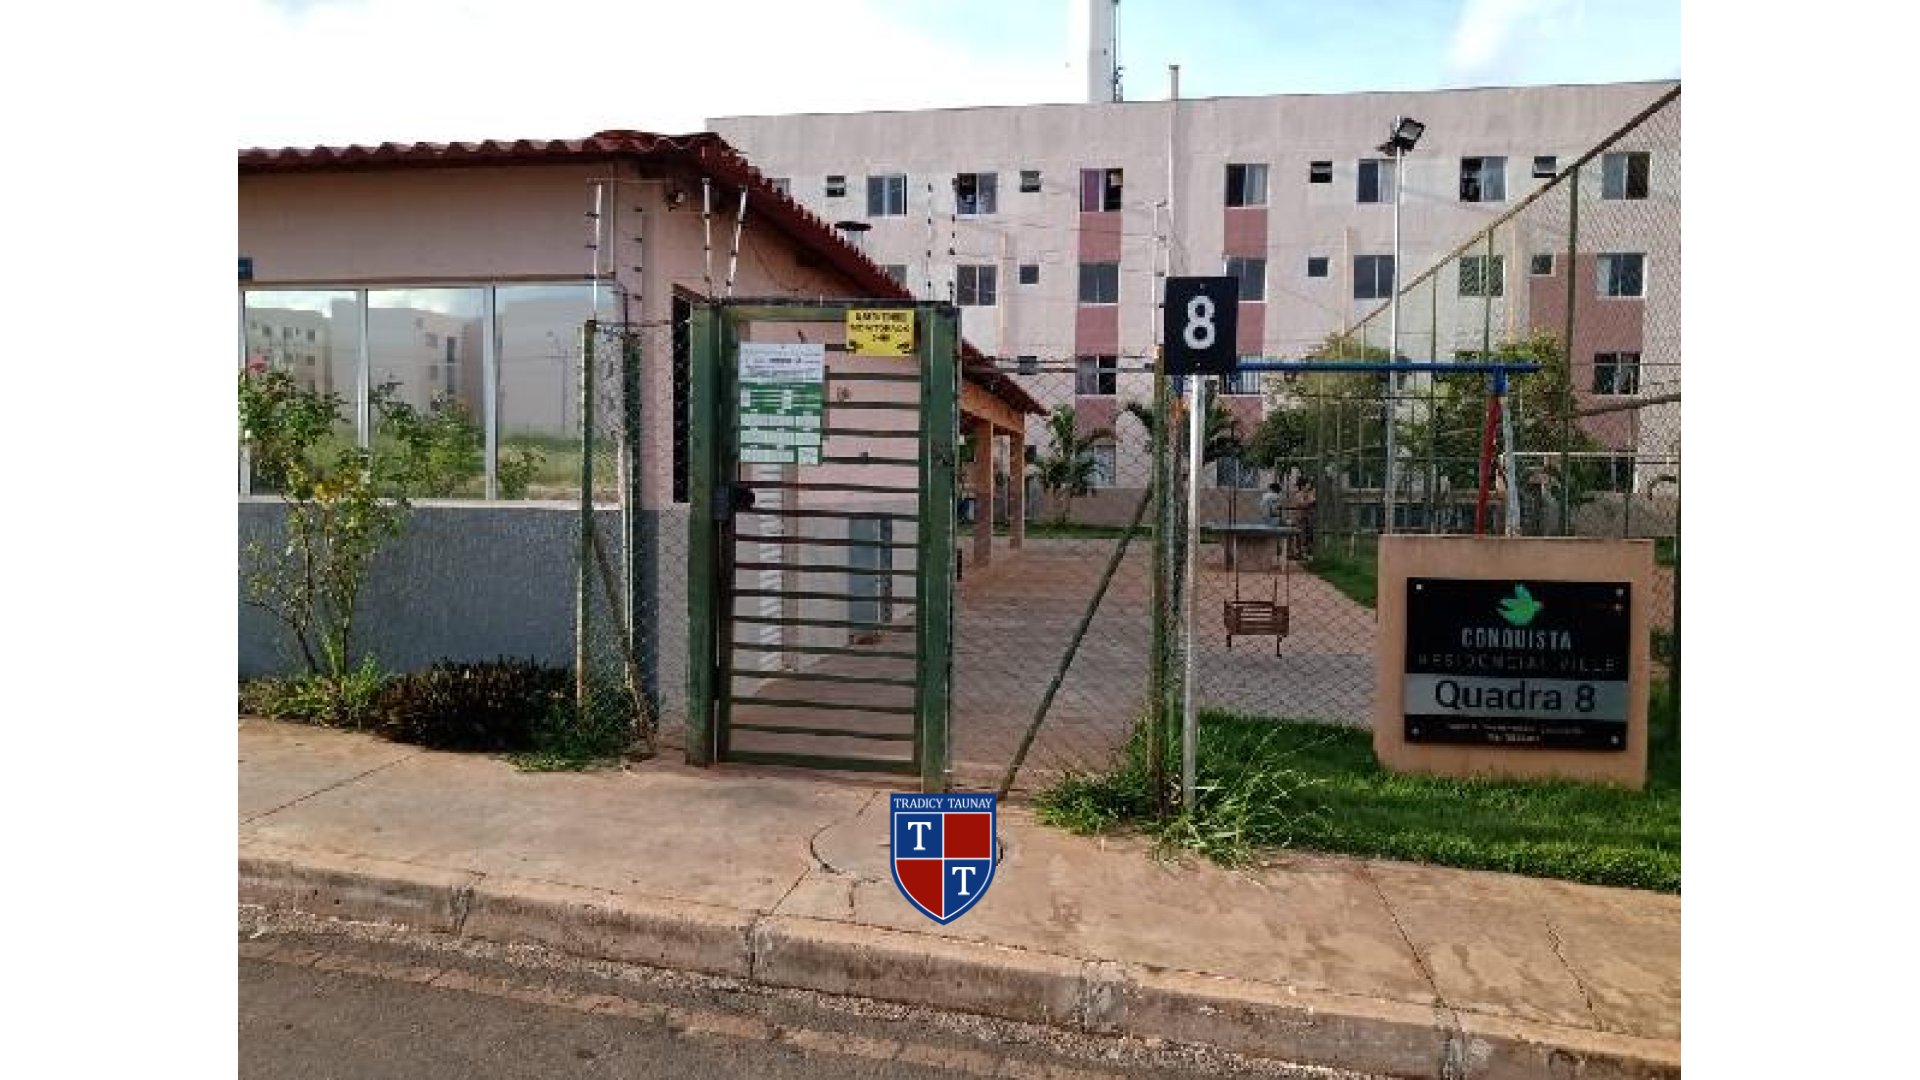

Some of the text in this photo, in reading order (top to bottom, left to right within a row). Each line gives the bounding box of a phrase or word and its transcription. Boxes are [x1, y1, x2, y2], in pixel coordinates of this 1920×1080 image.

[1183, 295, 1215, 350] 8
[1461, 627, 1571, 650] CONQUISTA
[1435, 680, 1596, 712] Quadra 8
